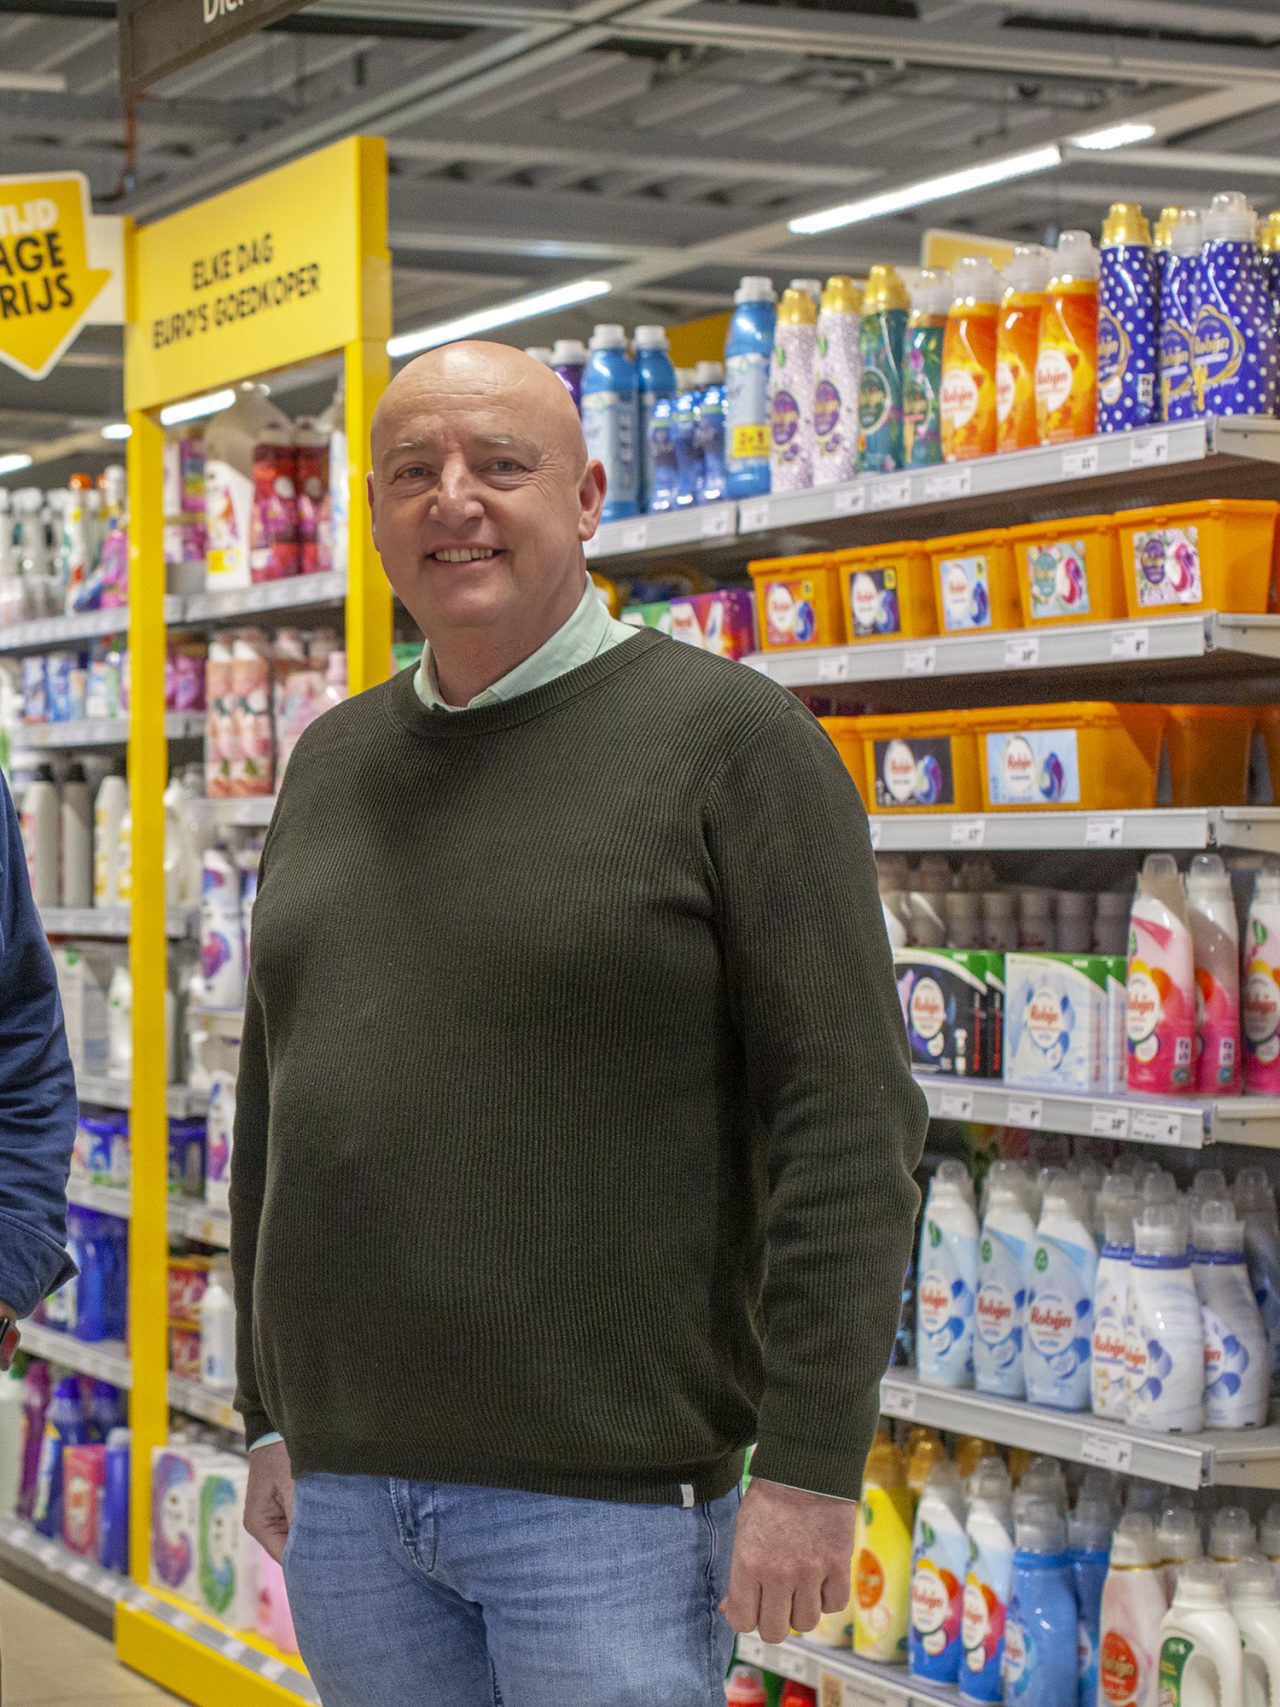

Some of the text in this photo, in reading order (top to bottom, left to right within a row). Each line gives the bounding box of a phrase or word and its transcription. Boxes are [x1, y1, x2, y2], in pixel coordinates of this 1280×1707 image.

[192, 232, 272, 290] ELKE DAG
[153, 263, 320, 349] EURO'S GOEDKOPER
